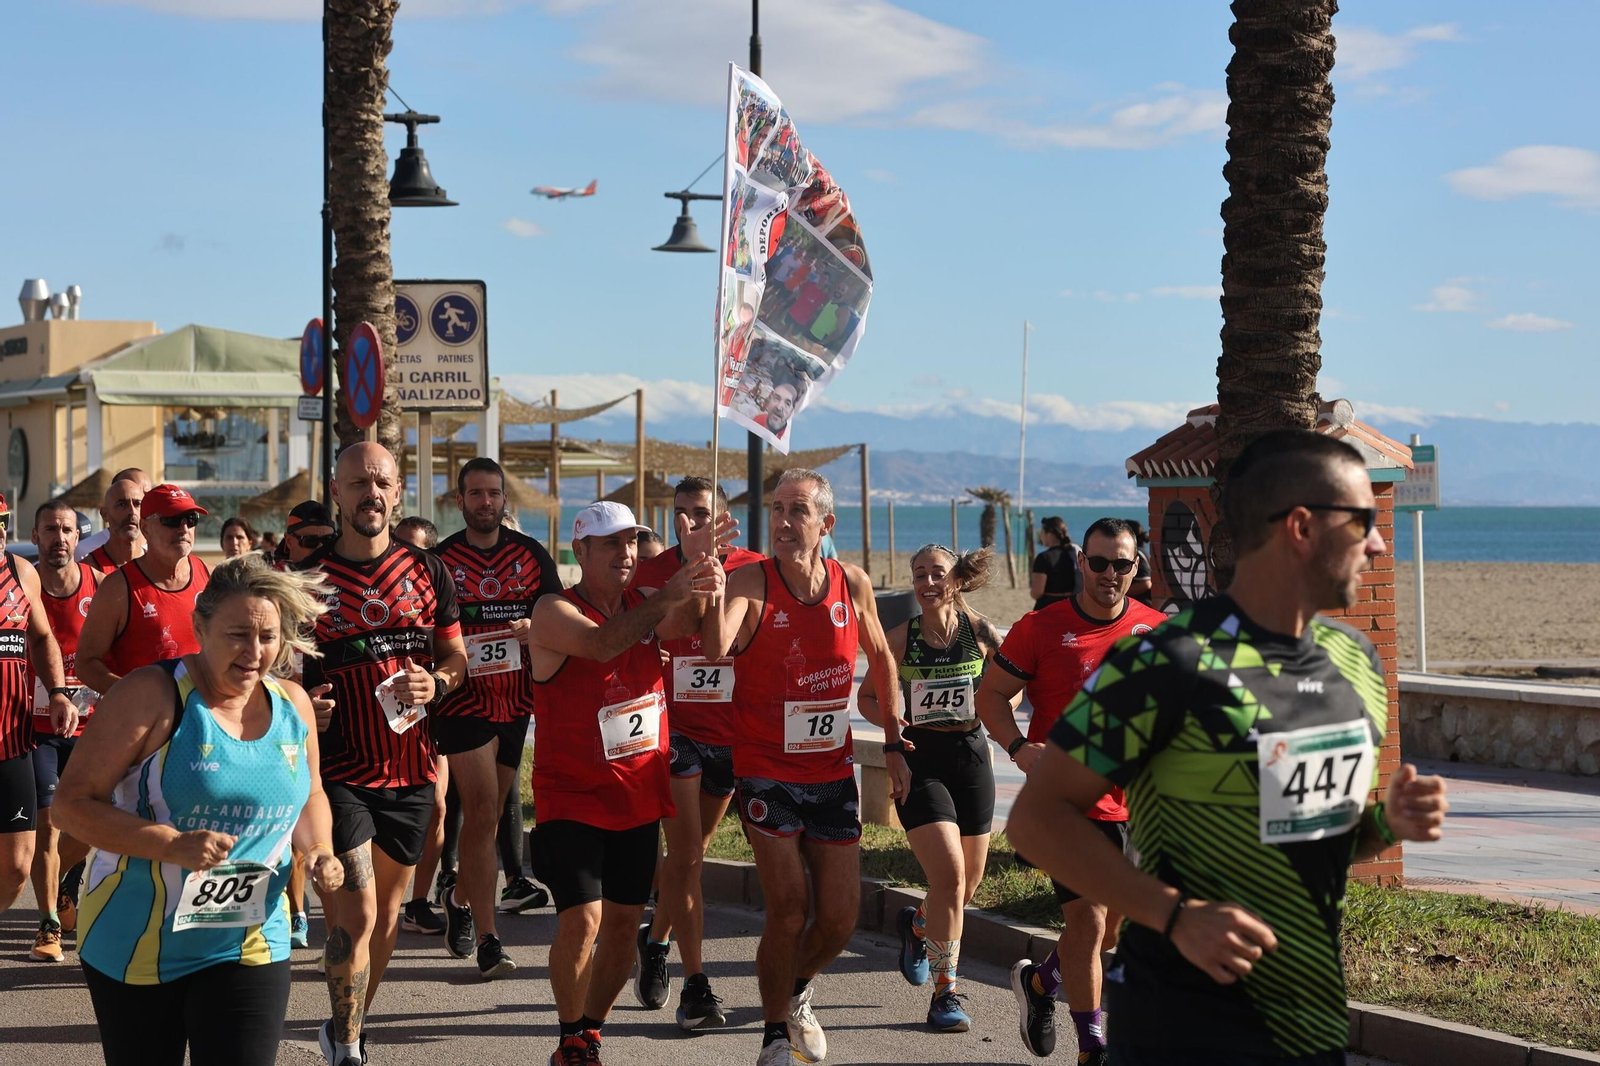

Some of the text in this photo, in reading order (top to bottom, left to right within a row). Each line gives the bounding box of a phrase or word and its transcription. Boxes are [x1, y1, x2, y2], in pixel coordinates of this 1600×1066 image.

[437, 354, 474, 364] PATINES
[409, 371, 472, 384] CARRIL
[362, 587, 380, 596] vive
[481, 604, 527, 612] kinetic
[369, 631, 427, 645] kinetic
[480, 641, 507, 663] 35
[797, 662, 852, 687] CORREDORES
[934, 664, 976, 674] kinetic
[690, 668, 721, 689] 34
[810, 674, 851, 694] CON MIGA
[1296, 677, 1325, 693] vive
[920, 687, 966, 709] 445
[629, 713, 644, 738] 2
[807, 714, 835, 737] 18
[190, 761, 220, 772] vive
[1281, 751, 1364, 805] 447
[191, 804, 295, 819] AL-ANDALUS
[191, 873, 260, 907] 805
[178, 915, 191, 924] 024
